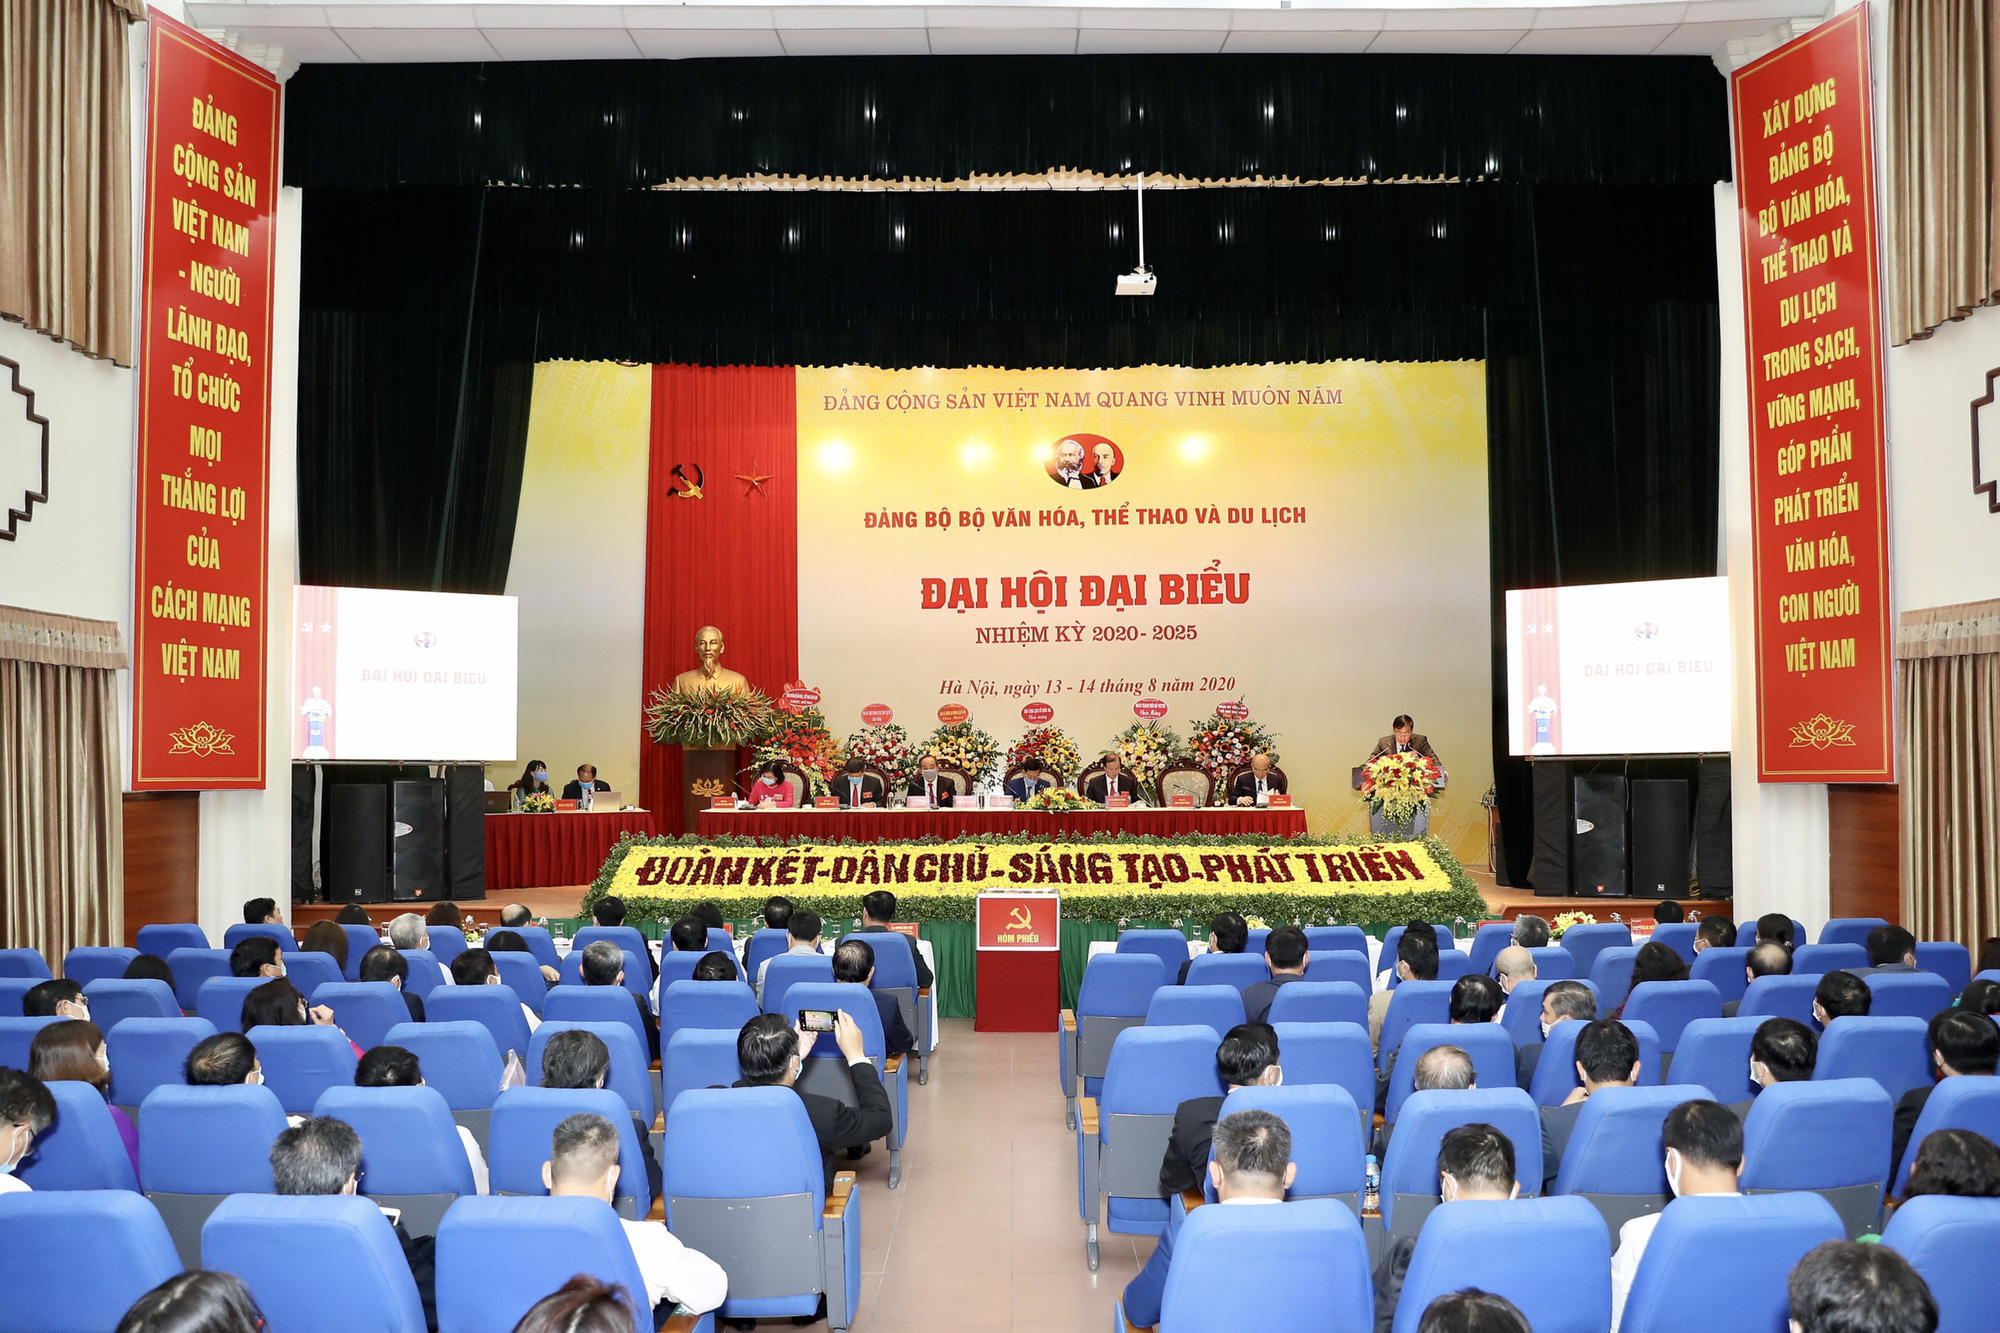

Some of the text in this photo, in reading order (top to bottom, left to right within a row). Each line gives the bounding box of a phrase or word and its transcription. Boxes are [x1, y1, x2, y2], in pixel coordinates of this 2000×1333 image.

[192, 95, 237, 146] ĐẢNG
[1763, 78, 1836, 138] XÂY DỰNG
[173, 143, 256, 207] CỘNG SẢN
[1769, 125, 1833, 184] ĐẢNG BỘ
[173, 198, 249, 257] VIỆT NAM
[1759, 175, 1850, 239] BỘ VĂN HÓA,
[1761, 219, 1853, 284] THỂ THAO VÀ
[191, 260, 240, 306] NGƯỜI
[1780, 282, 1836, 327] DU LỊCH
[168, 305, 251, 367] LÃNH ĐẠO,
[1763, 327, 1859, 381] TRONG SẠCH,
[172, 357, 240, 412] TỔ CHỨC
[824, 385, 1342, 413] ĐẢNG CỘNG SẢN VIỆT NAM QUANG VINH MUÔN NĂM
[1767, 379, 1859, 429] VỮNG MẠNH,
[190, 425, 221, 467] MỌI
[1778, 424, 1852, 475] GÓP PHẦN
[161, 467, 245, 525] THẮNG LỢI
[864, 501, 1305, 532] ĐẢNG BỘ BỘ VĂN HÓA, THỂ THAO VÀ DU LỊCH
[1775, 472, 1858, 525] PHÁT TRIỂN
[187, 527, 220, 569] CỦA
[1786, 531, 1854, 572] VĂN HÓA,
[152, 581, 250, 631] CÁCH MẠNG
[921, 559, 1250, 614] ĐẠI HỘI ĐẠI BIỂU
[1780, 579, 1859, 623] CON NGƯỜI
[976, 621, 1049, 647] NHIỆM
[1055, 620, 1086, 642] KỲ
[1153, 625, 1197, 640] 2025
[1785, 637, 1855, 677] VIỆT NAM
[162, 638, 239, 683] VIỆT NAM
[939, 680, 962, 694] Hà
[967, 680, 998, 699] Nội,
[1004, 680, 1040, 698] ngày
[1046, 680, 1062, 693] 13
[1079, 679, 1095, 693] 14
[1100, 678, 1143, 696] tháng
[1148, 678, 1157, 692] 8
[1162, 678, 1194, 691] năm
[1199, 677, 1235, 691] 2020
[635, 848, 749, 886] ĐOÀN
[1008, 844, 1113, 883] SÁNG
[1294, 844, 1424, 882] TRIỂN
[997, 931, 1039, 943] HÒM PHIẾU
